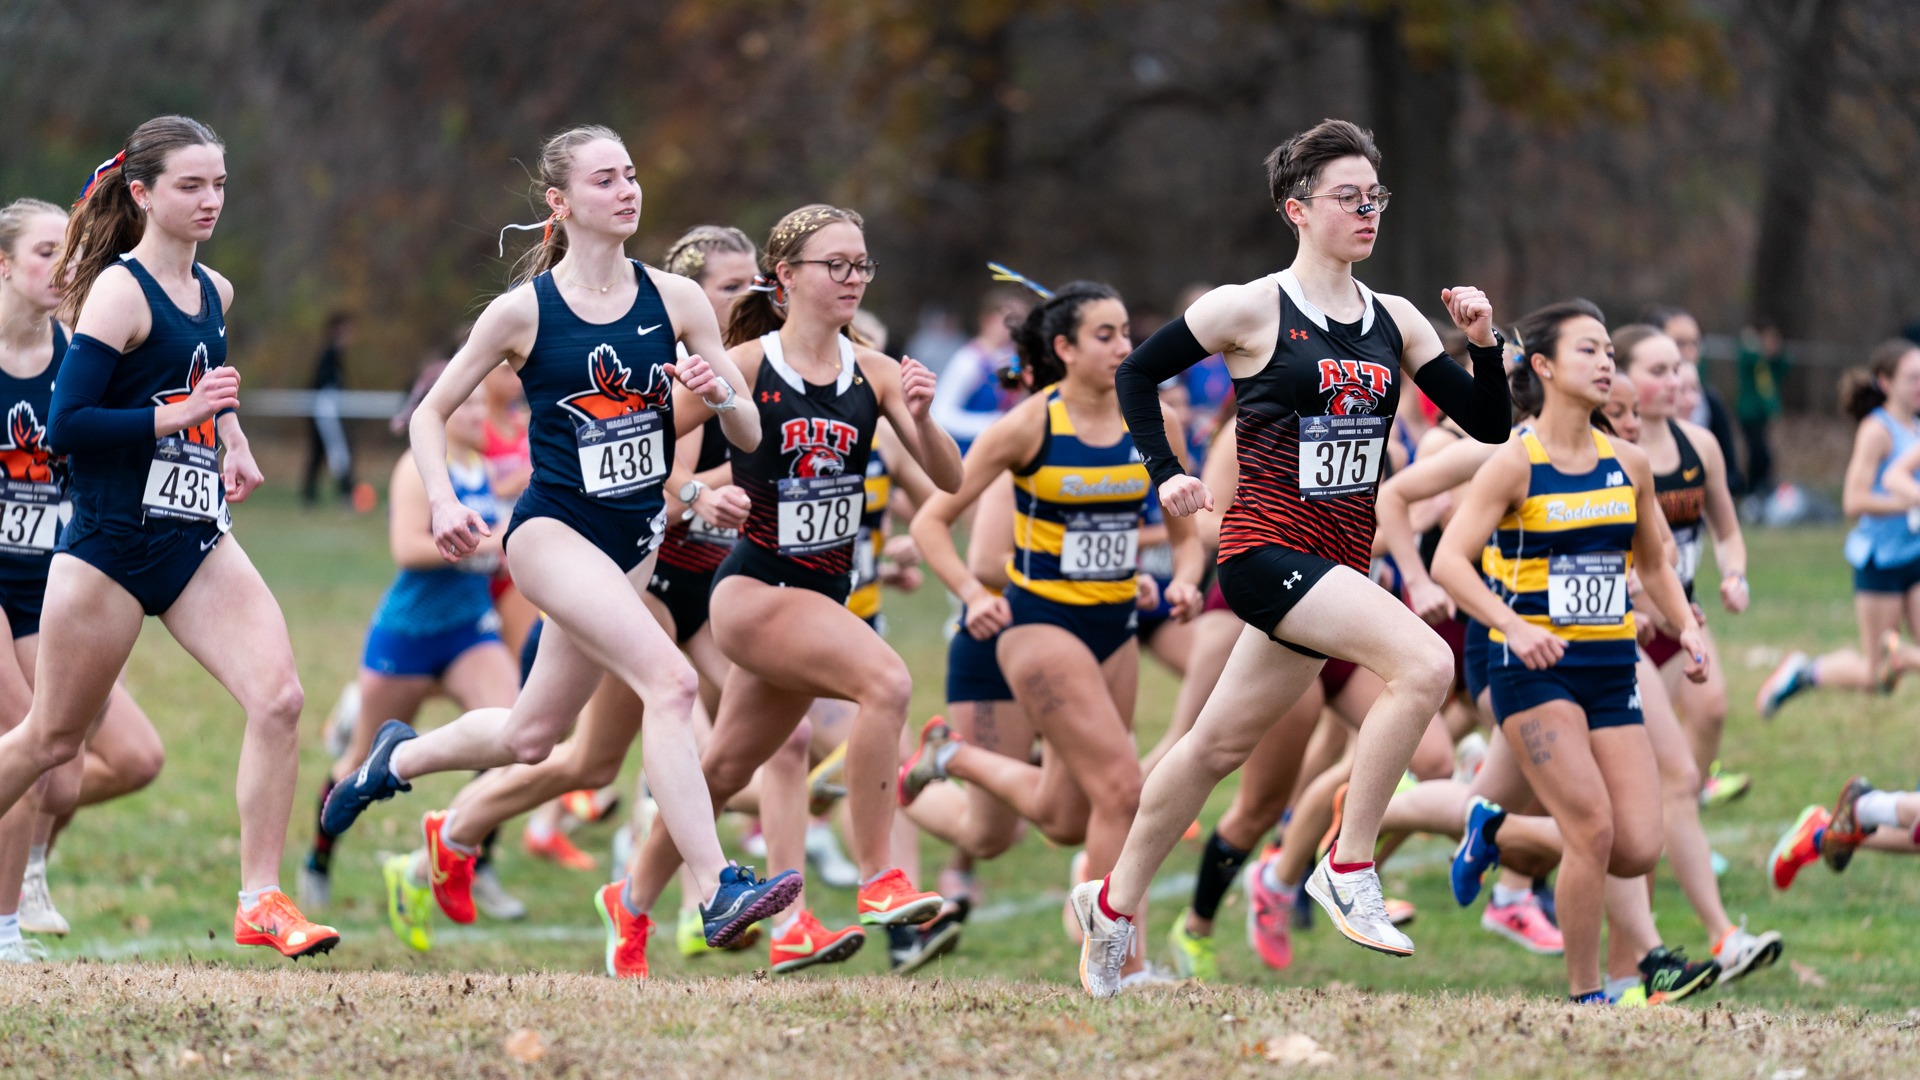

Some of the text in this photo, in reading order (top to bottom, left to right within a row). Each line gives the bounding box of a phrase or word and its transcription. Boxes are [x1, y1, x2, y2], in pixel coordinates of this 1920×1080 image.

[1318, 359, 1392, 398] RIT
[781, 417, 858, 455] RIT
[1331, 417, 1381, 427] NIAGARA REGIONAL
[599, 437, 653, 484] 438
[1316, 440, 1370, 486] 375
[159, 466, 210, 512] 435
[796, 497, 850, 543] 378
[1545, 499, 1630, 523] Rochester
[1077, 533, 1128, 568] 389
[1565, 576, 1616, 615] 387
